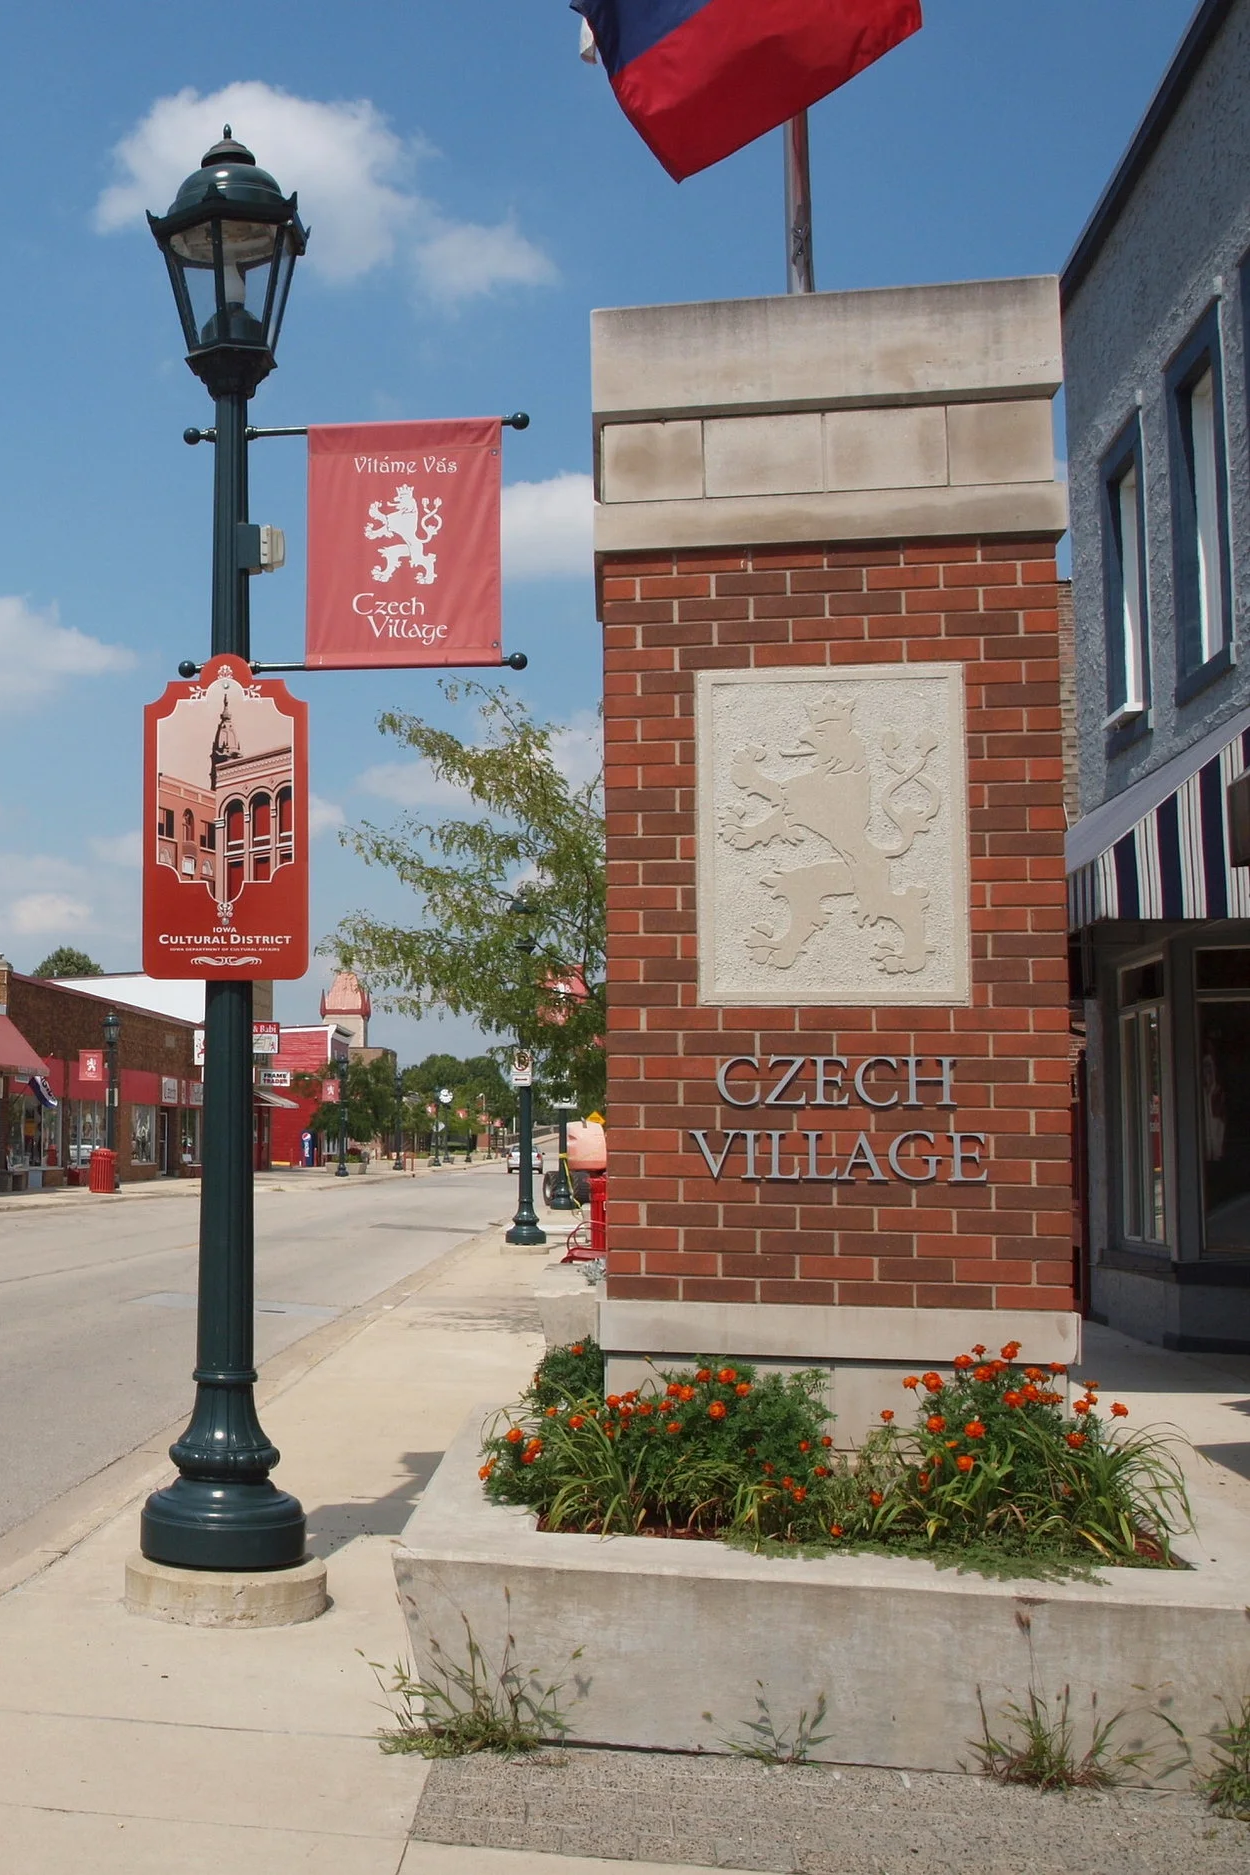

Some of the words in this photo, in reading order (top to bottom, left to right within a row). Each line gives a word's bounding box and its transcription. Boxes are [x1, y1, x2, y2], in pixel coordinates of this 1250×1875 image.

[423, 455, 458, 473] Vás
[352, 593, 425, 616] Czech
[367, 615, 448, 645] Village
[158, 934, 227, 945] CULTURAL
[230, 934, 292, 945] DISTRICT
[260, 1024, 277, 1033] Babi
[716, 1054, 957, 1107] CZECH
[689, 1130, 989, 1183] VILLAGE
